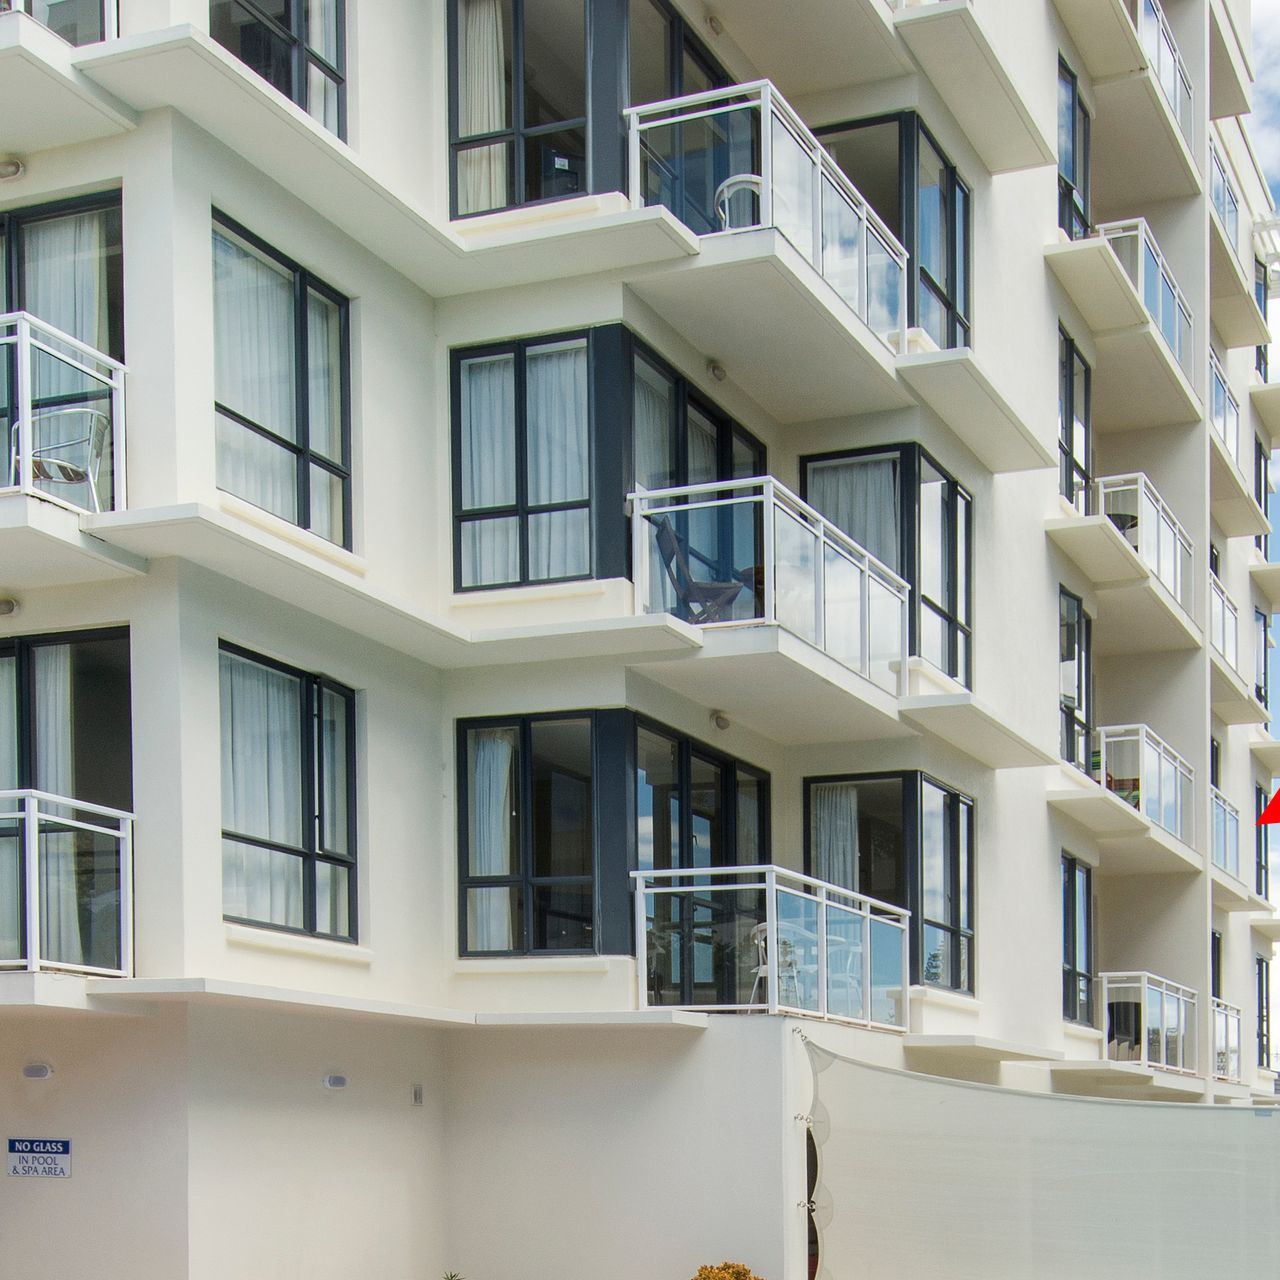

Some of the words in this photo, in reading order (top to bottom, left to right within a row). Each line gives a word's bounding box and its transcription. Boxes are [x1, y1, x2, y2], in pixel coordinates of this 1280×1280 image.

[15, 1142, 31, 1151] NO
[33, 1142, 63, 1152] GLASS
[18, 1155, 29, 1164] IN
[32, 1156, 59, 1165] POOL
[12, 1166, 20, 1175] &
[22, 1166, 39, 1175] SPA
[41, 1166, 65, 1176] AREA
